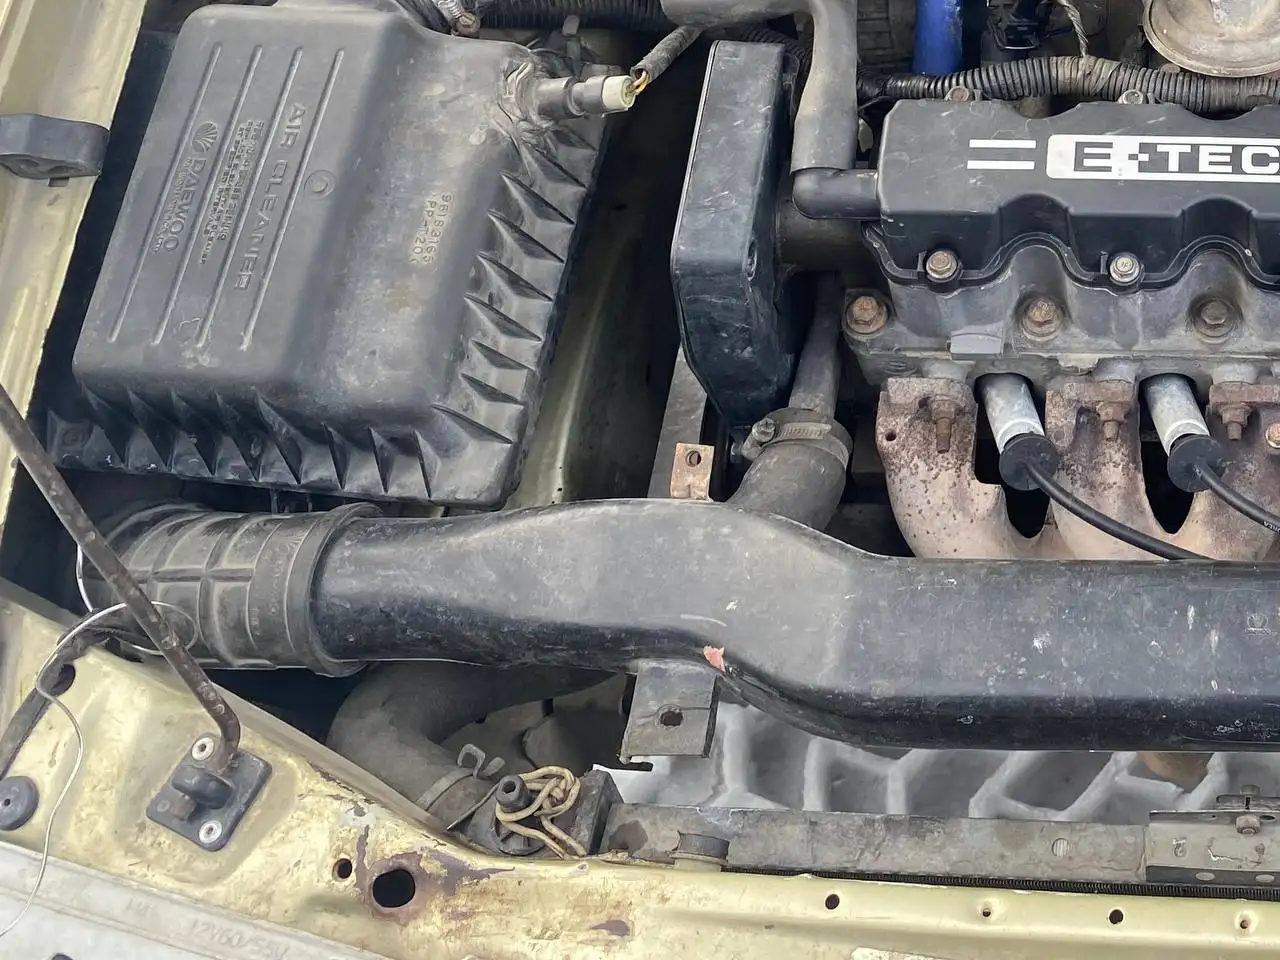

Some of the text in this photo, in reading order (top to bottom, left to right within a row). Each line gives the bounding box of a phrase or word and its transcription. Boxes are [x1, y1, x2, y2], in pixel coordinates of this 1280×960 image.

[280, 102, 307, 149] AIR
[1074, 141, 1280, 176] E-TEC
[164, 158, 207, 252] DAEWOO
[234, 159, 287, 290] CLEANER
